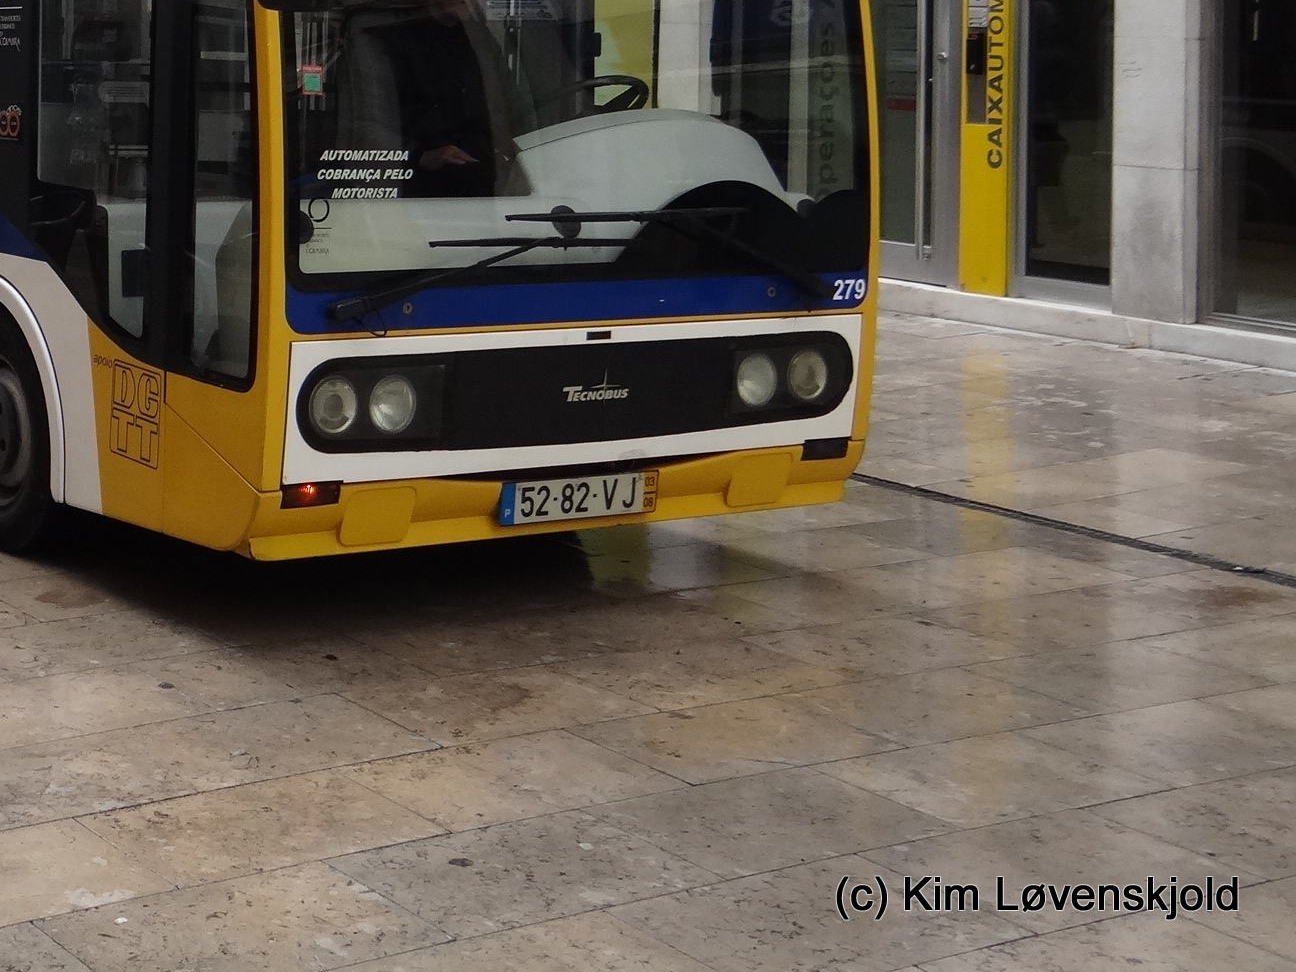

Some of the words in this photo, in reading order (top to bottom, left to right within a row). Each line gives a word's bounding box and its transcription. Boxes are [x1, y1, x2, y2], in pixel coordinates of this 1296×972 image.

[319, 150, 410, 161] AUTOMATIZADA
[317, 169, 381, 182] COBRANÇA
[383, 169, 414, 180] PELO
[331, 188, 399, 199] MOTORISTA
[832, 278, 866, 301] 279
[93, 355, 113, 369] apoio
